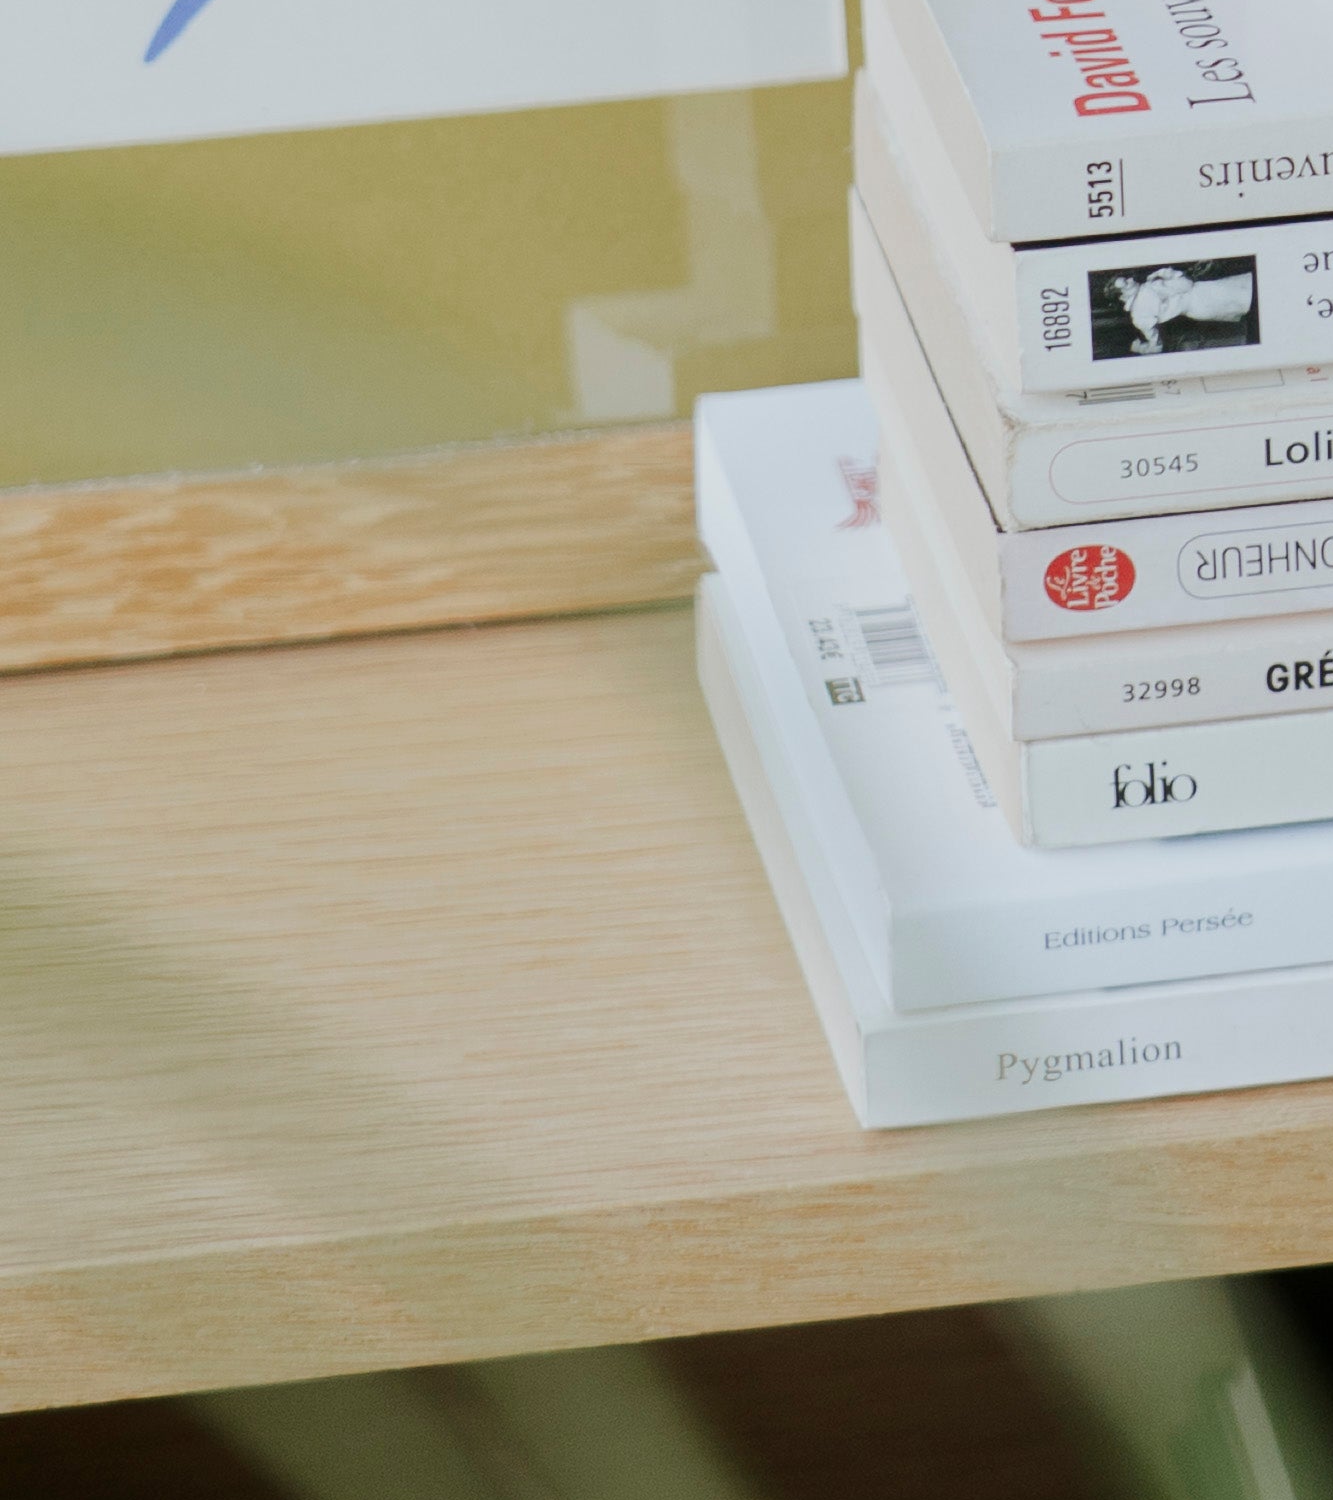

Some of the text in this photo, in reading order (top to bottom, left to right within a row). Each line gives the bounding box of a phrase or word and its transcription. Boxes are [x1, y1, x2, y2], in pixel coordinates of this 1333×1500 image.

[1041, 28, 1151, 118] David
[1189, 55, 1256, 109] Les
[1088, 161, 1115, 218] 5513
[1042, 286, 1070, 351] 16892
[1120, 453, 1199, 479] 30545
[1067, 549, 1089, 608] Livre
[1094, 545, 1119, 608] Poche
[1122, 677, 1202, 703] 32998
[1111, 761, 1198, 810] folio
[1044, 905, 1254, 952] Editions Persée
[997, 1036, 1183, 1084] Pygmalion
